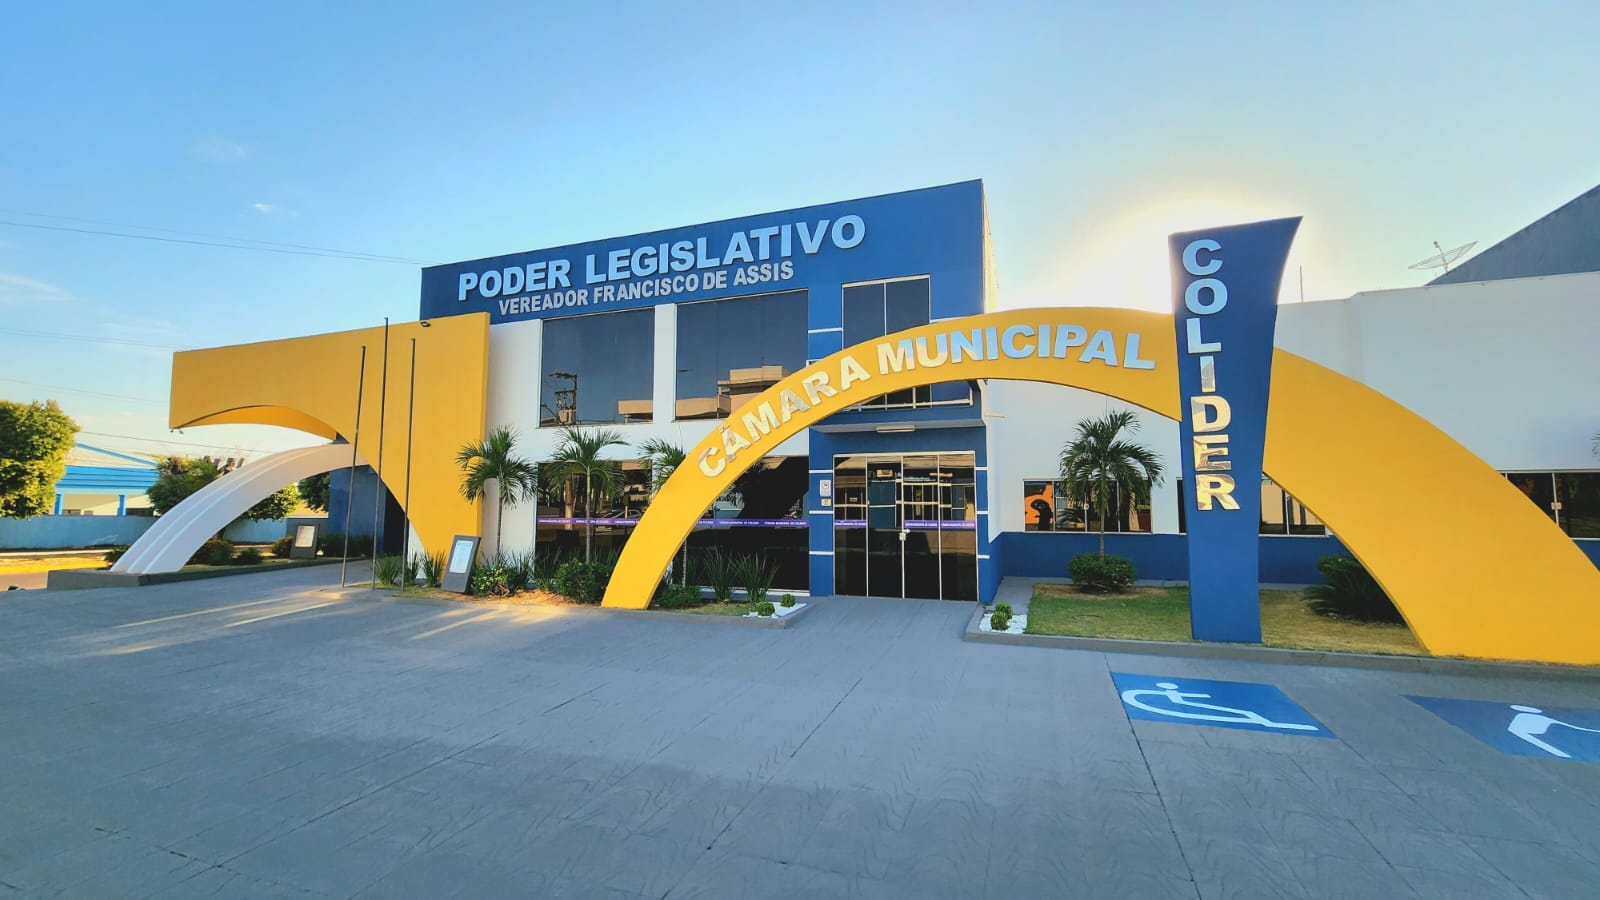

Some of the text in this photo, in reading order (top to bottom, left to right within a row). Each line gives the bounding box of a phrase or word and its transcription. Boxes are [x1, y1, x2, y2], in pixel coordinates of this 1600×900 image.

[458, 214, 866, 301] PODER LEGISLATIVO
[498, 261, 794, 316] VEREADOR FRANCISCO DE ASSIS
[698, 323, 1156, 477] CÂMARA MUNICIPAL
[1182, 239, 1240, 511] COLIDER
